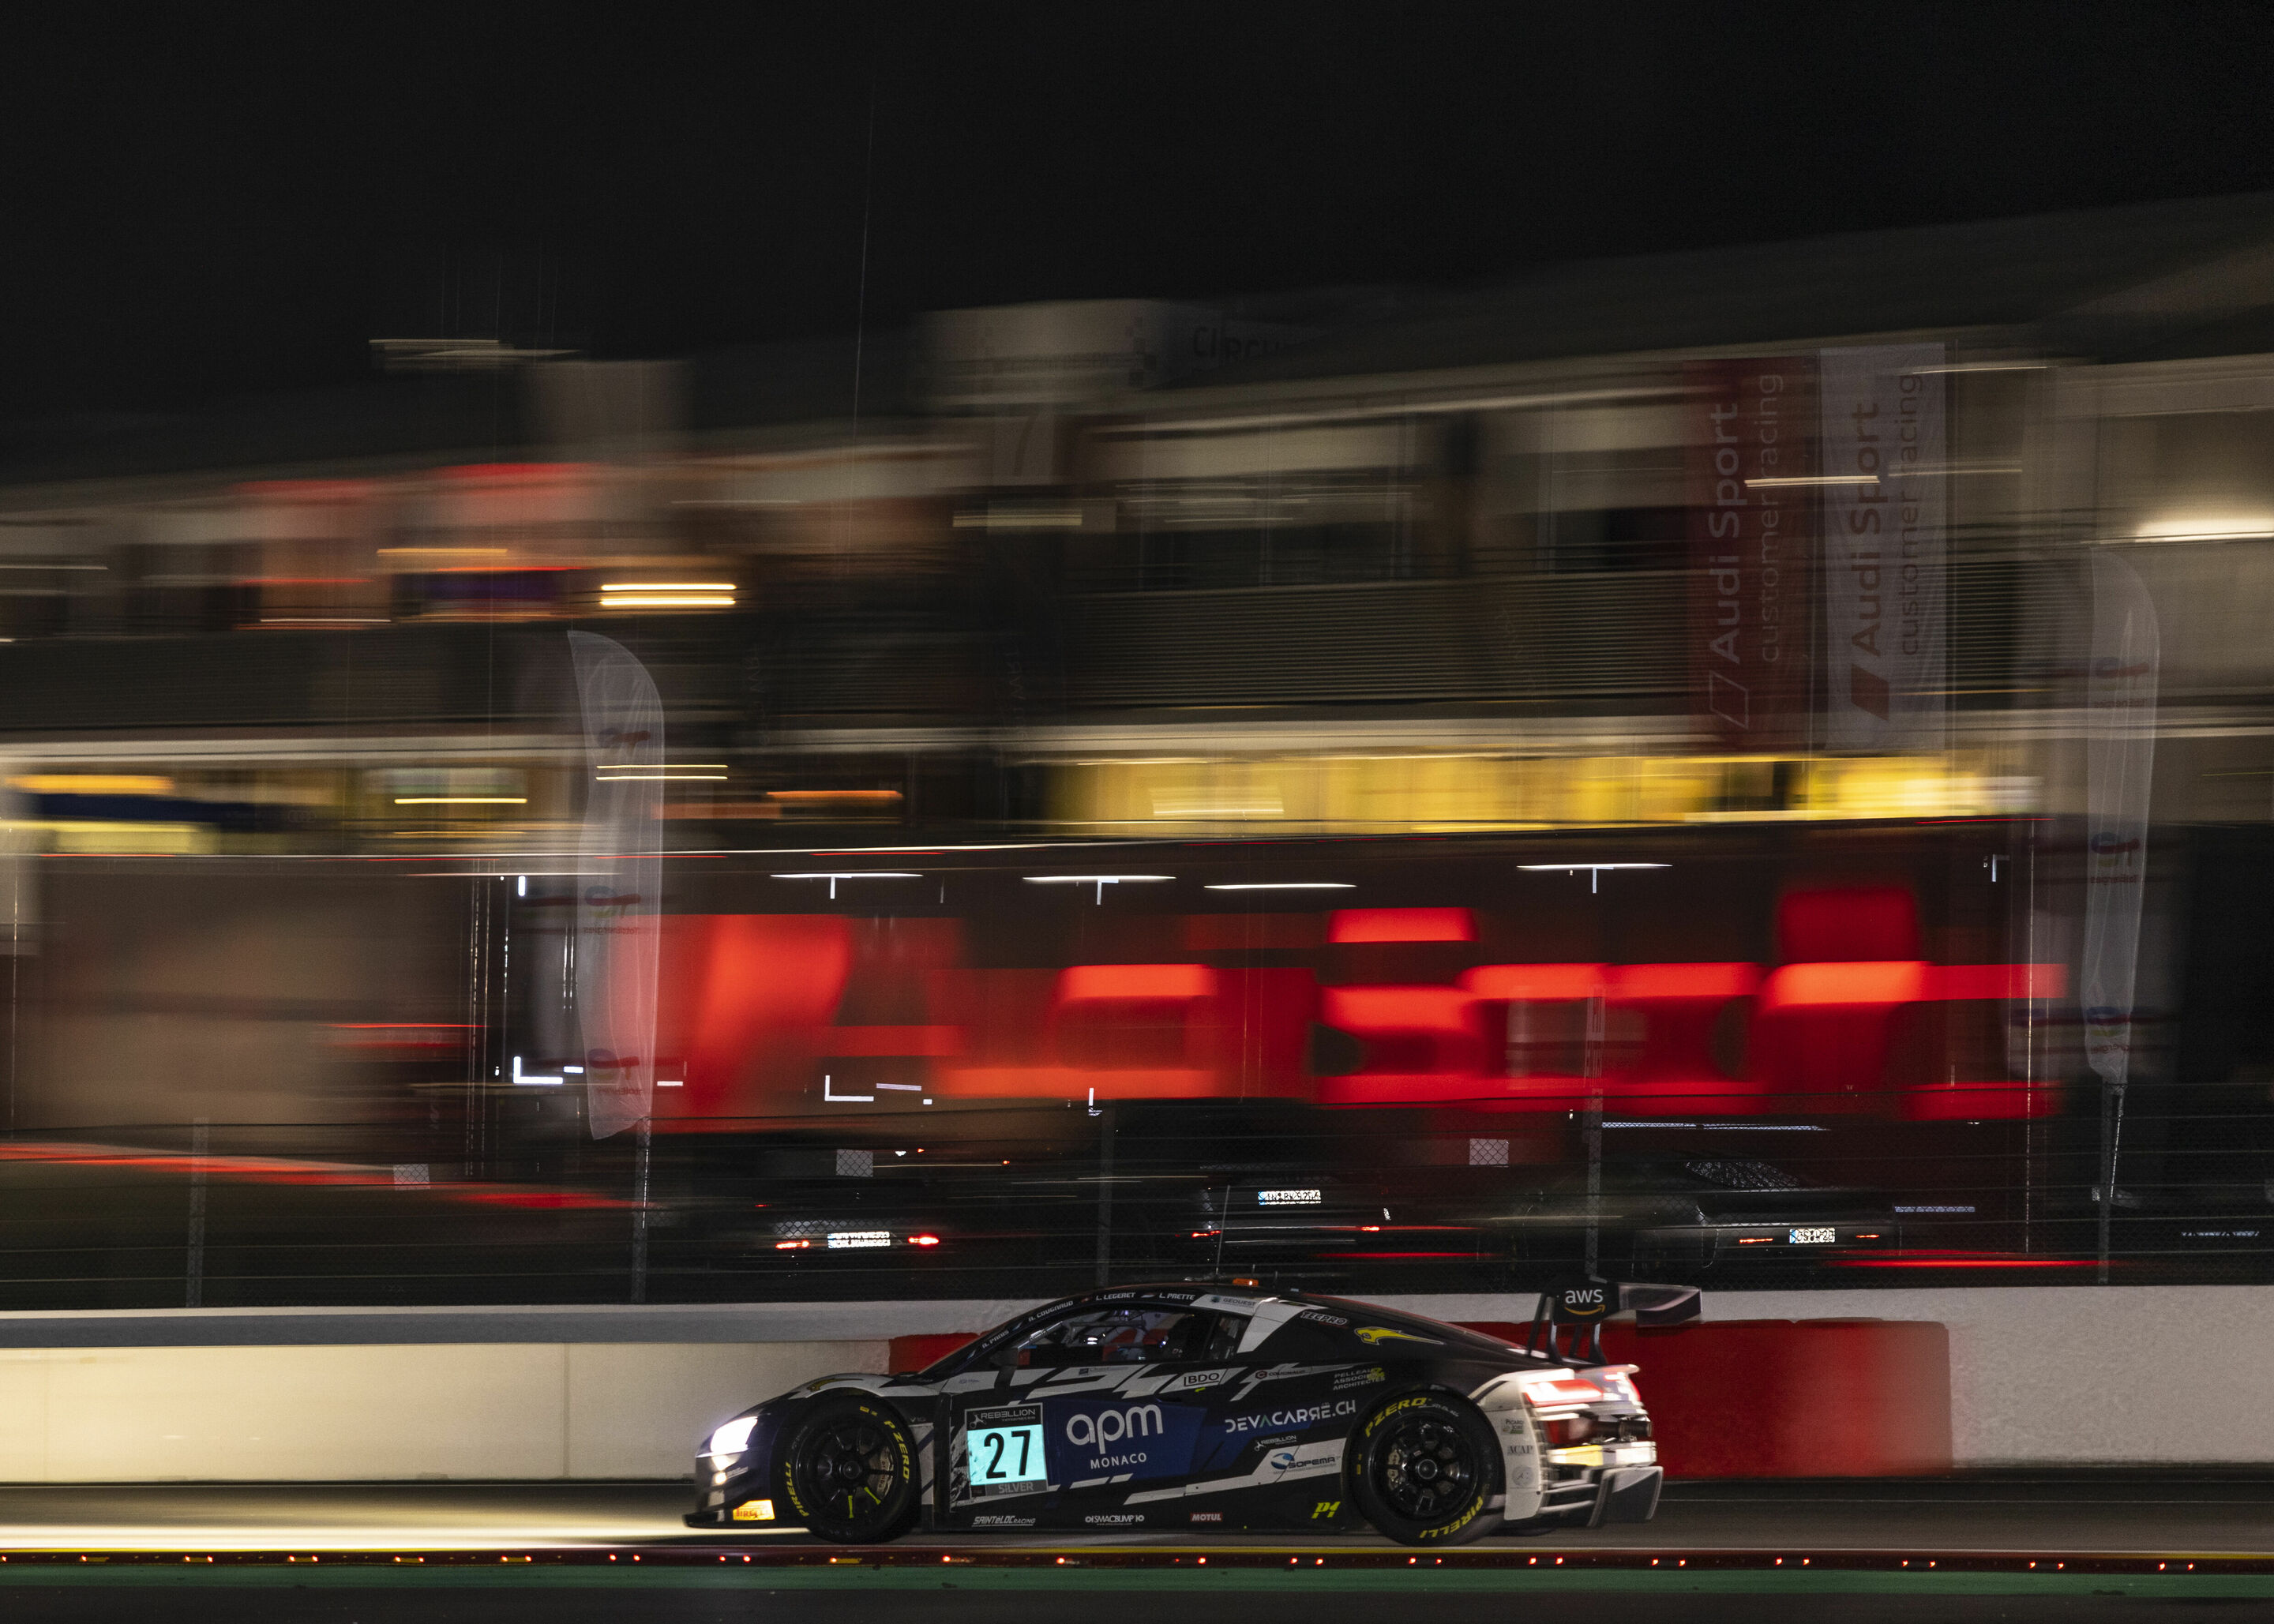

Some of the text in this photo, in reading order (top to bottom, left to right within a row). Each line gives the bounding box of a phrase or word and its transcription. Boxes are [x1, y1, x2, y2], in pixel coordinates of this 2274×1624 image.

[1755, 373, 1783, 662] customer racing
[1851, 403, 1889, 657] Audi Sport
[1709, 403, 1747, 664] Audi Sport
[1899, 491, 1919, 656] customer
[1565, 1288, 1604, 1303] aws
[1300, 1311, 1348, 1326] TECPRO
[1188, 1372, 1220, 1384] BDO
[1066, 1404, 1164, 1455] apm
[984, 1430, 1031, 1480] 27
[1090, 1453, 1147, 1470] MONACO
[1288, 1456, 1336, 1469] SOPEMA
[998, 1481, 1034, 1494] SILVER
[1191, 1513, 1221, 1522] MOTUL
[1419, 1495, 1484, 1539] PIRELLI
